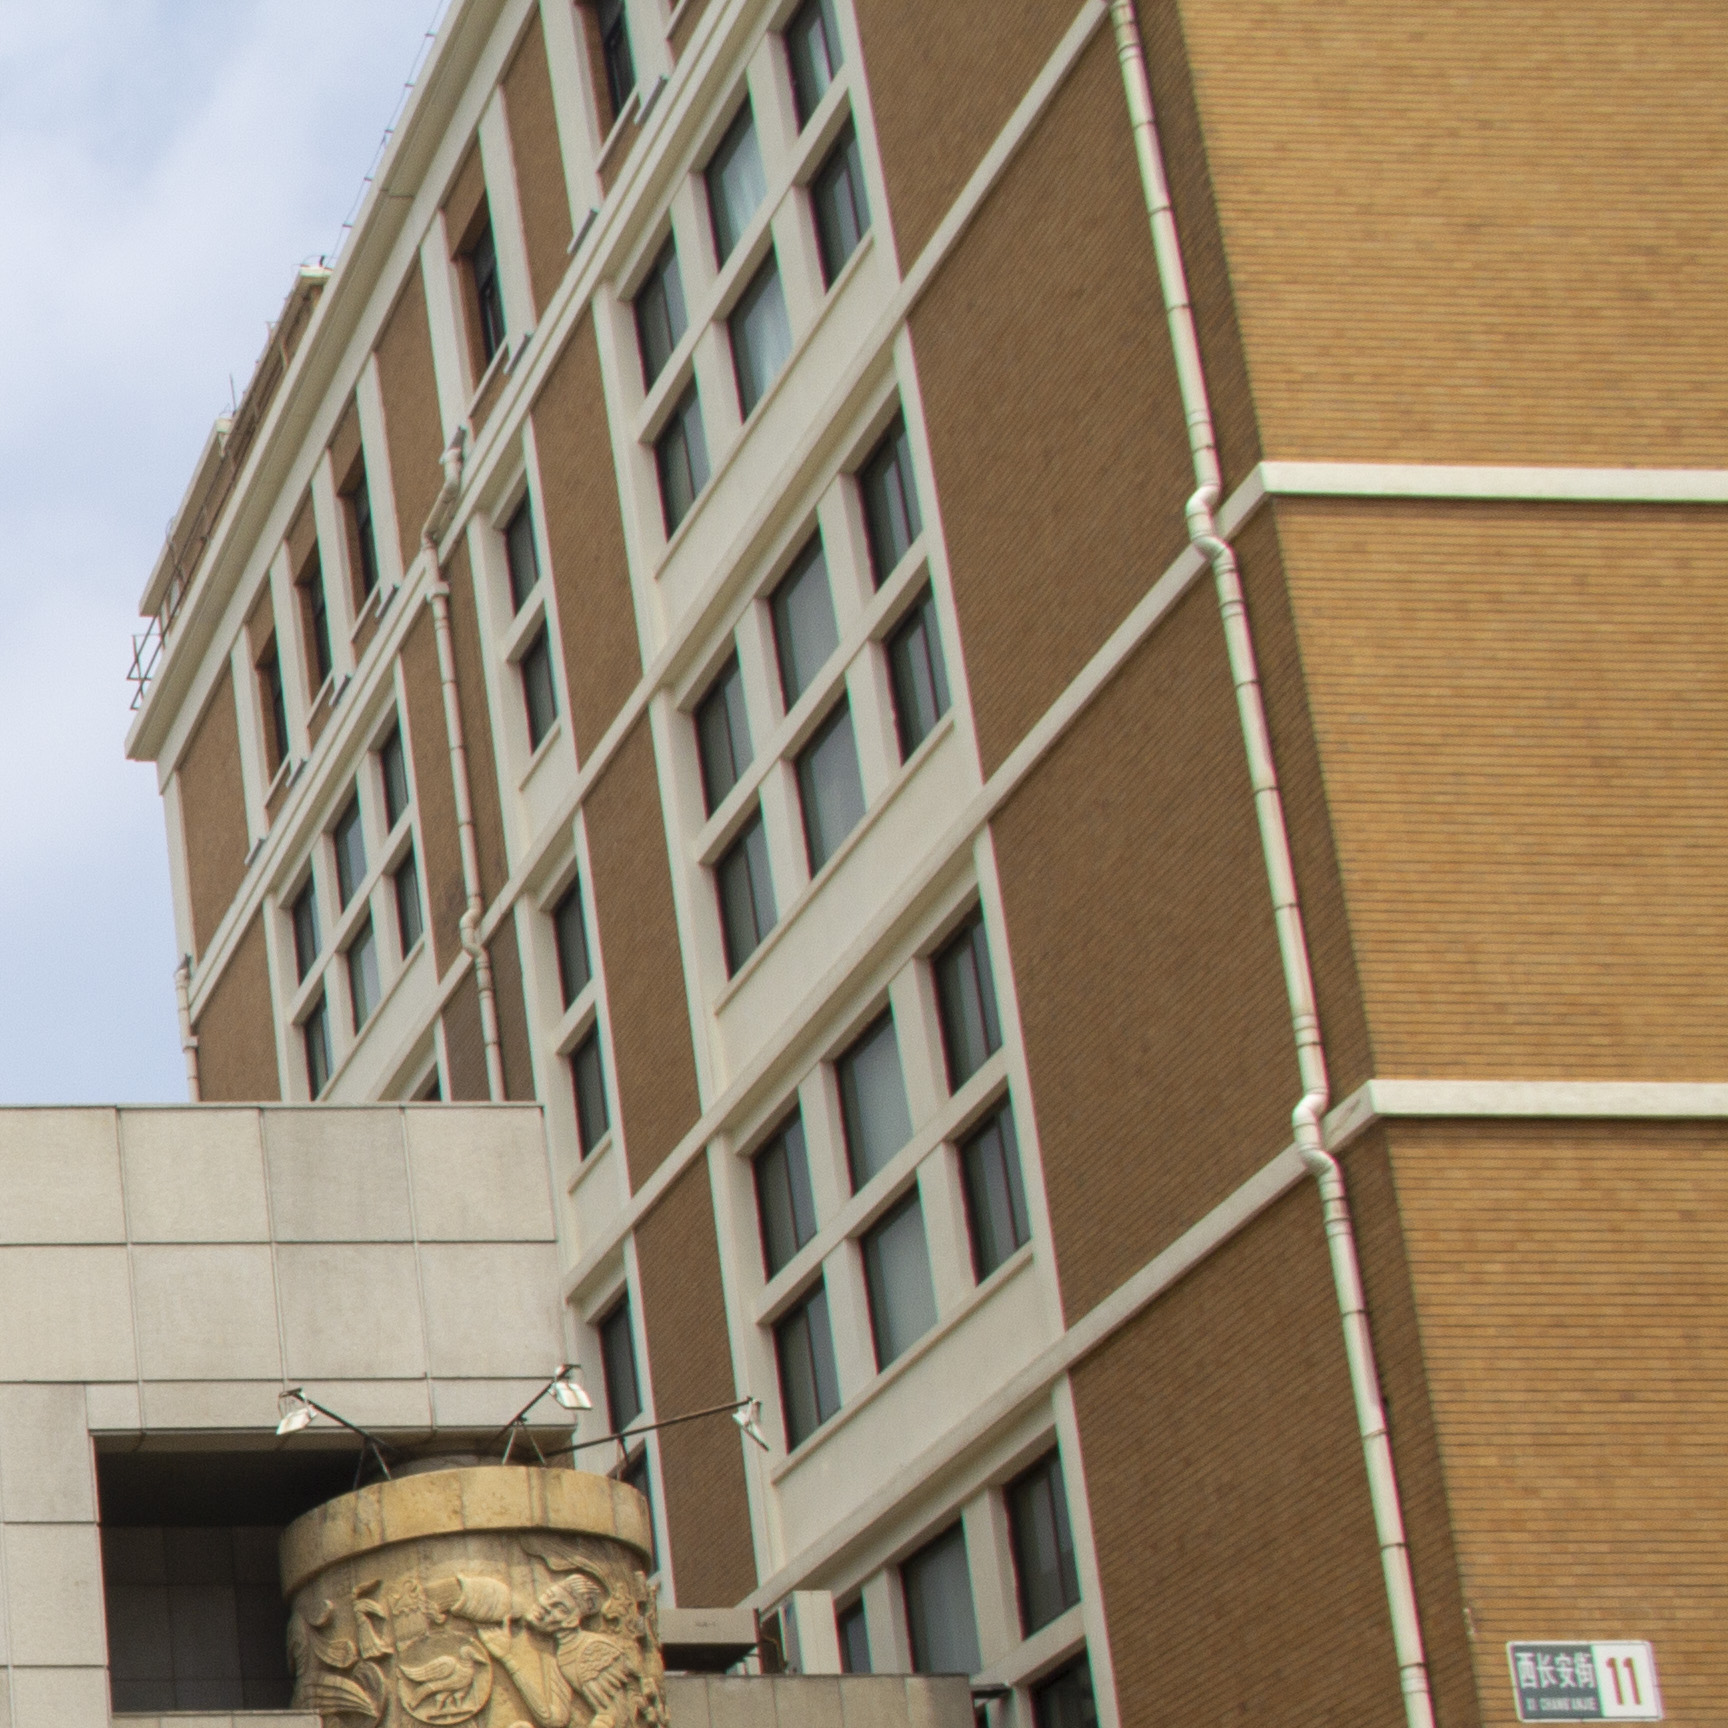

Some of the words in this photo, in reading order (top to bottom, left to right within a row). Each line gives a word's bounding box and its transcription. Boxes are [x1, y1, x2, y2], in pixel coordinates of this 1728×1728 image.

[1515, 1652, 1597, 1689] 西长安街
[1605, 1656, 1642, 1706] 11
